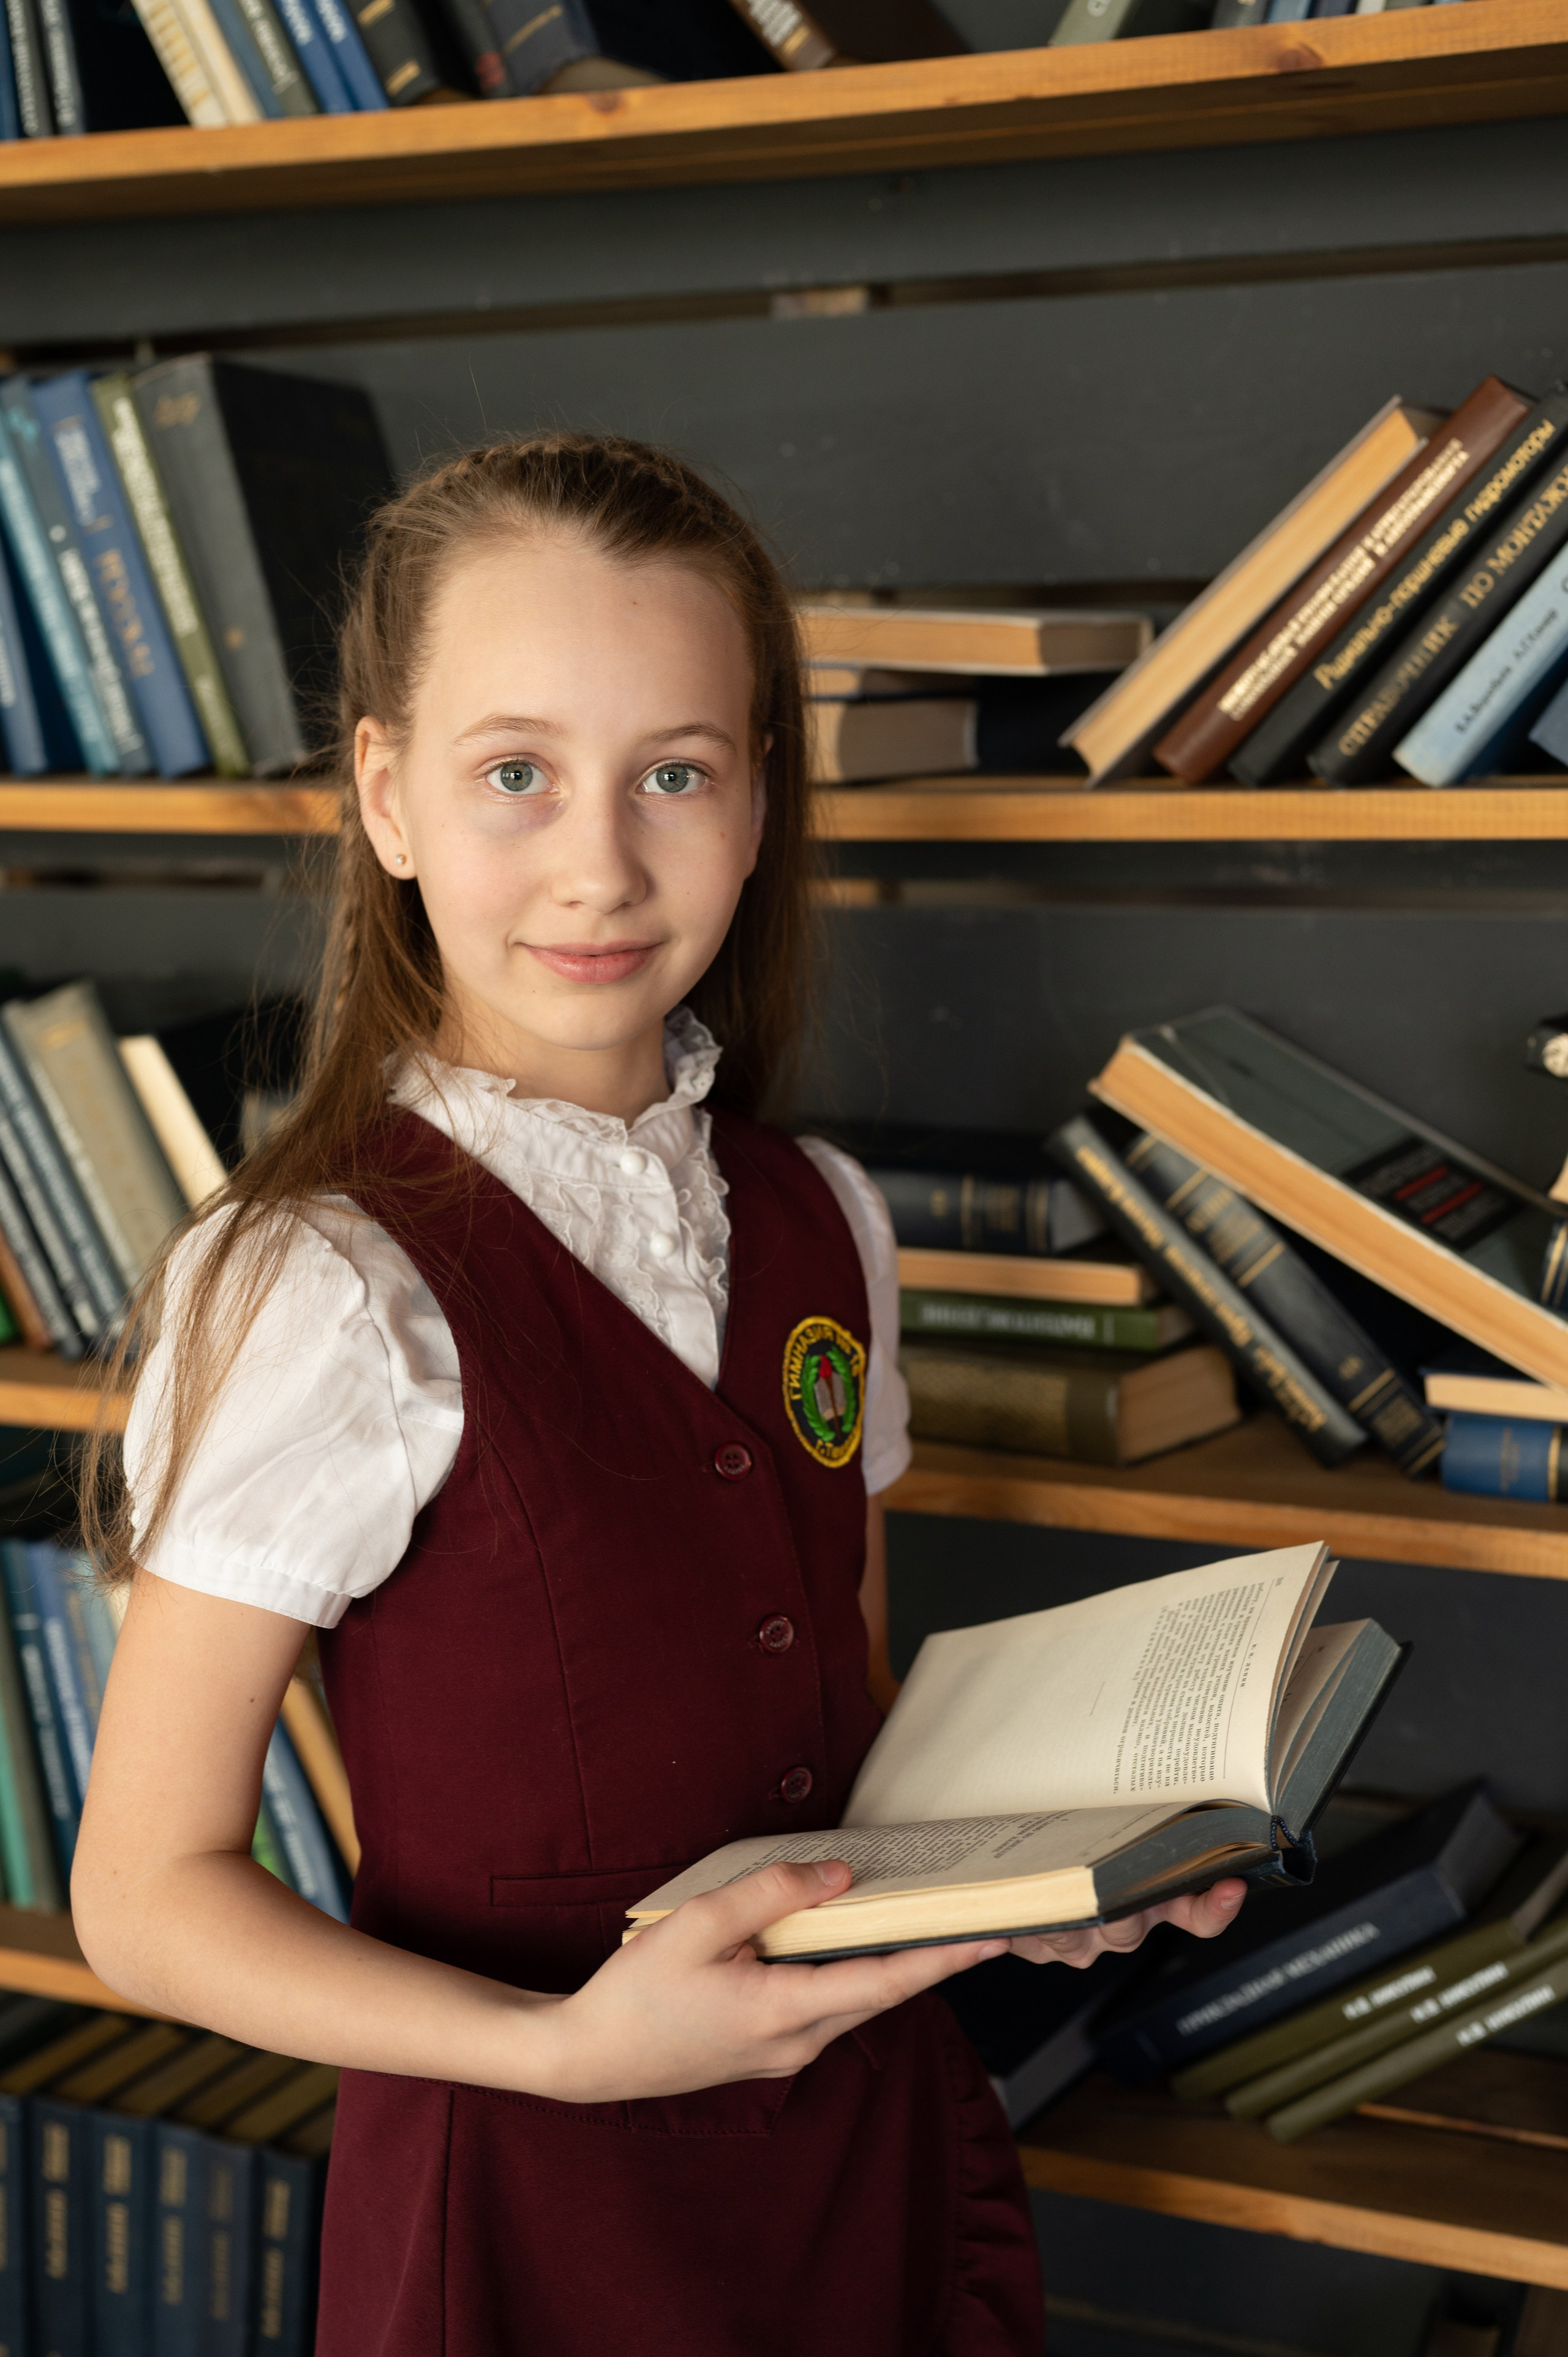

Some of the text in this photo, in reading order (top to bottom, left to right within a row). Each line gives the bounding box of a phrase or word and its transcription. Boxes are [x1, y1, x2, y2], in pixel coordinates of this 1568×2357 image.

[1310, 418, 1560, 692] Радиально-поршневые гидромоторы
[1335, 611, 1461, 760] СПРАВОЧНИК
[1458, 567, 1497, 610] ПО
[1184, 1657, 1197, 1679] нужно
[1207, 1654, 1221, 1678] уровне
[1218, 1648, 1231, 1671] наших
[1167, 1674, 1184, 1707] программ
[1182, 1680, 1189, 1688] на
[1187, 1668, 1202, 1692] работу
[1196, 1667, 1208, 1691] только
[1209, 1674, 1223, 1700] уездов,
[1220, 1660, 1235, 1692] изучение
[1130, 1680, 1153, 1727] преобладают.
[1156, 1683, 1172, 1717] примеров
[1173, 1690, 1186, 1719] съездах
[1185, 1696, 1192, 1707] мы
[1189, 1694, 1200, 1720] числом
[1196, 1680, 1213, 1724] совершенно
[1214, 1694, 1226, 1719] опыта,
[1120, 1707, 1134, 1733] должен
[1133, 1719, 1146, 1749] налицо,
[1159, 1708, 1174, 1747] собраний,
[1176, 1711, 1188, 1742] должны
[1202, 1703, 1216, 1741] волостей,
[1145, 1718, 1162, 1790] удовлетворитель-
[1165, 1721, 1178, 1760] перенести
[1180, 1723, 1194, 1785] высокоудовле-
[1188, 1728, 1202, 1783] неудовлетво-
[1207, 1722, 1220, 1781] подтягивание
[1111, 1735, 1126, 1794] ограничиться.
[1129, 1752, 1139, 1792] отсталых
[1137, 1744, 1148, 1791] подтягива-
[1157, 1757, 1163, 1767] на
[1165, 1763, 1171, 1773] не
[1171, 1748, 1183, 1786] перейти.
[1197, 1746, 1208, 1782] которые
[1164, 1776, 1170, 1787] на
